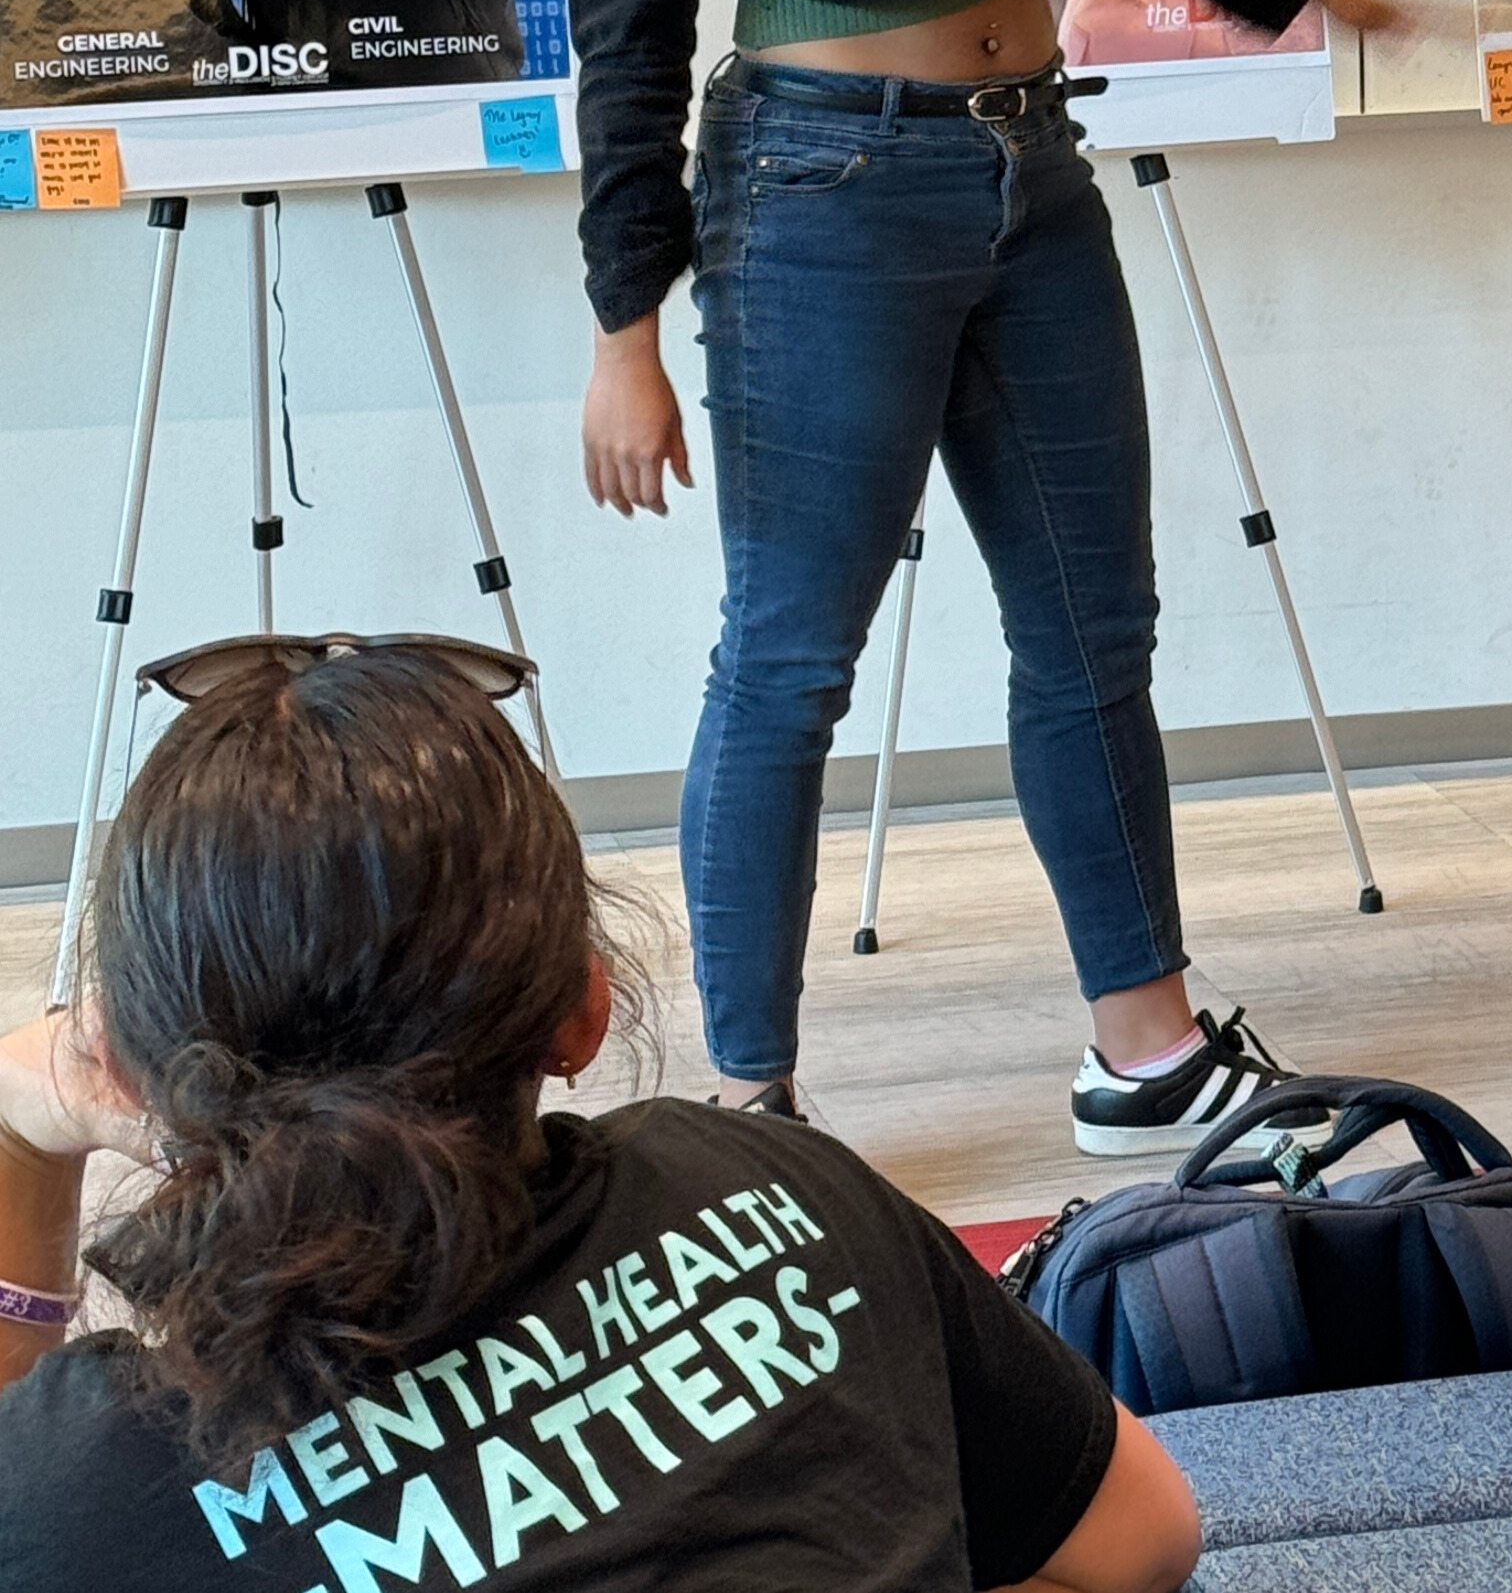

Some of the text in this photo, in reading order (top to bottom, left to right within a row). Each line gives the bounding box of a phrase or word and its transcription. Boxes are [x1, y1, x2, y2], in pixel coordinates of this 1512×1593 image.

[349, 17, 403, 34] CIVIL
[58, 32, 164, 52] GENERAL
[351, 36, 499, 59] ENGINEERING
[15, 56, 169, 80] ENGINEERING
[193, 1182, 825, 1560] MENTAL HEALTH
